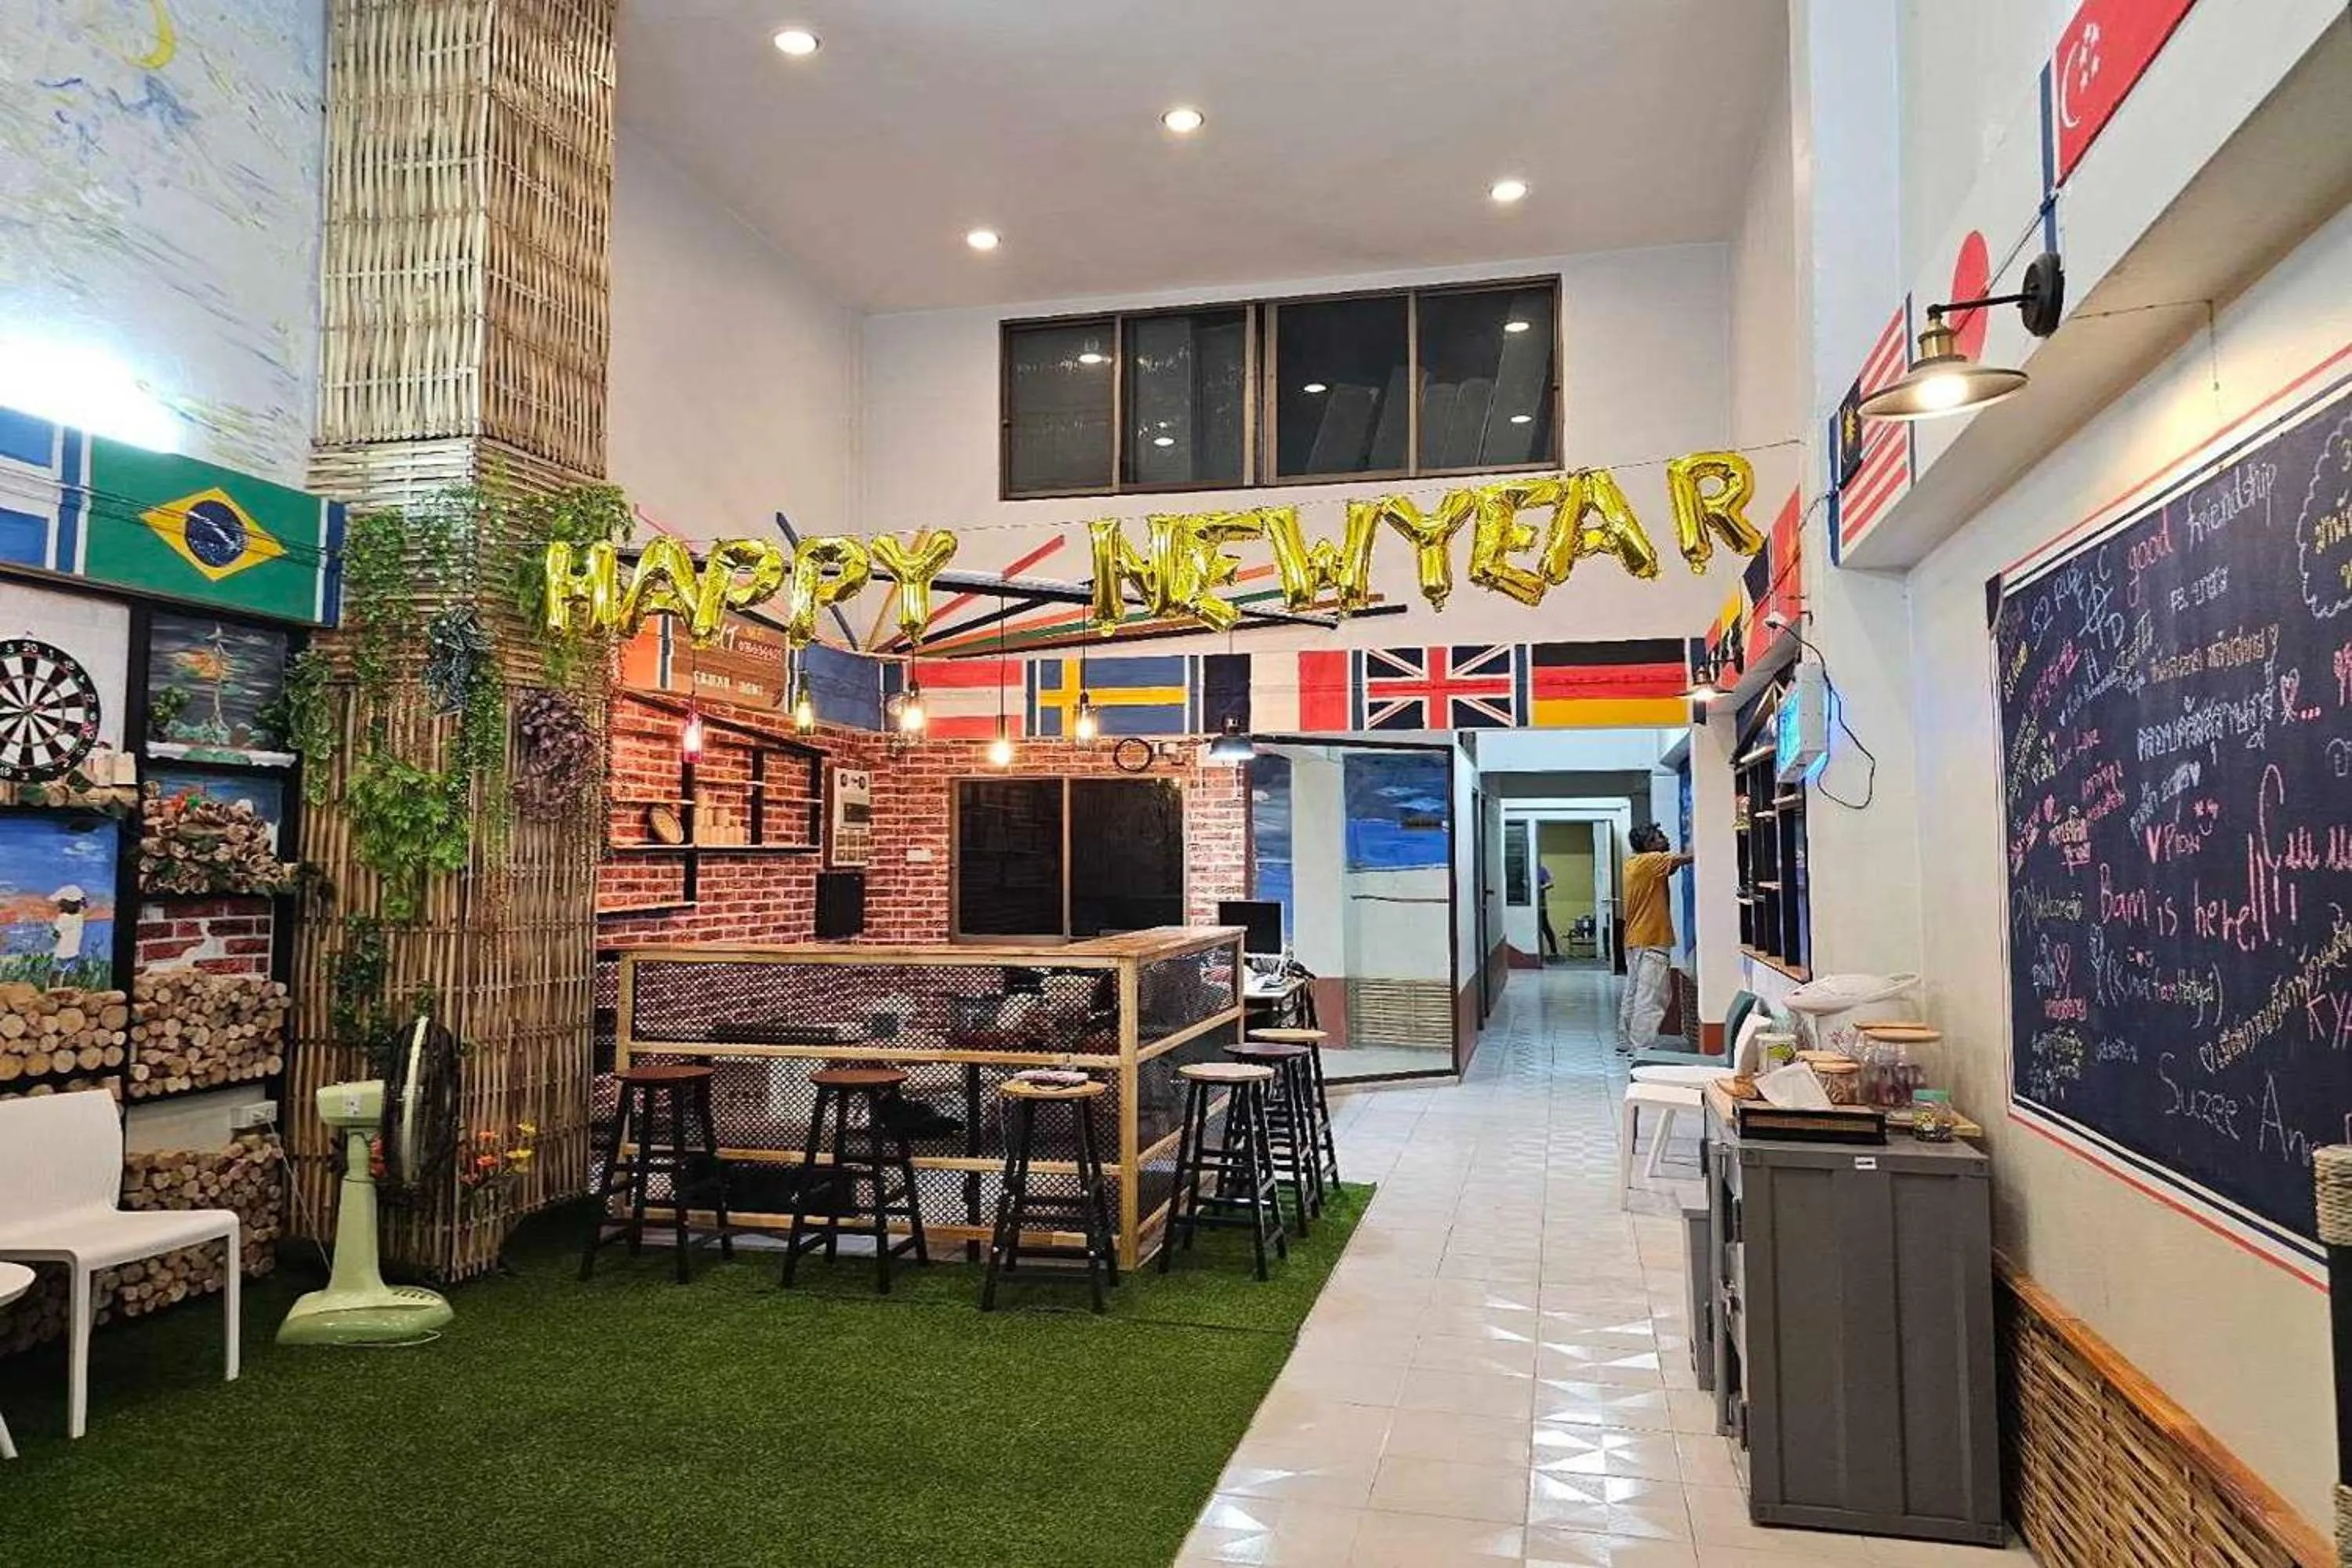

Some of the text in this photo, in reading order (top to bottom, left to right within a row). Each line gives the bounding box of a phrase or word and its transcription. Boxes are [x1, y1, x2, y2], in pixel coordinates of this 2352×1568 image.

[2128, 502, 2172, 608] good
[2186, 463, 2278, 553] friendship
[546, 529, 959, 649] HAPPY
[22, 641, 39, 654] 20
[2099, 862, 2149, 930] Bam
[2156, 888, 2179, 938] is
